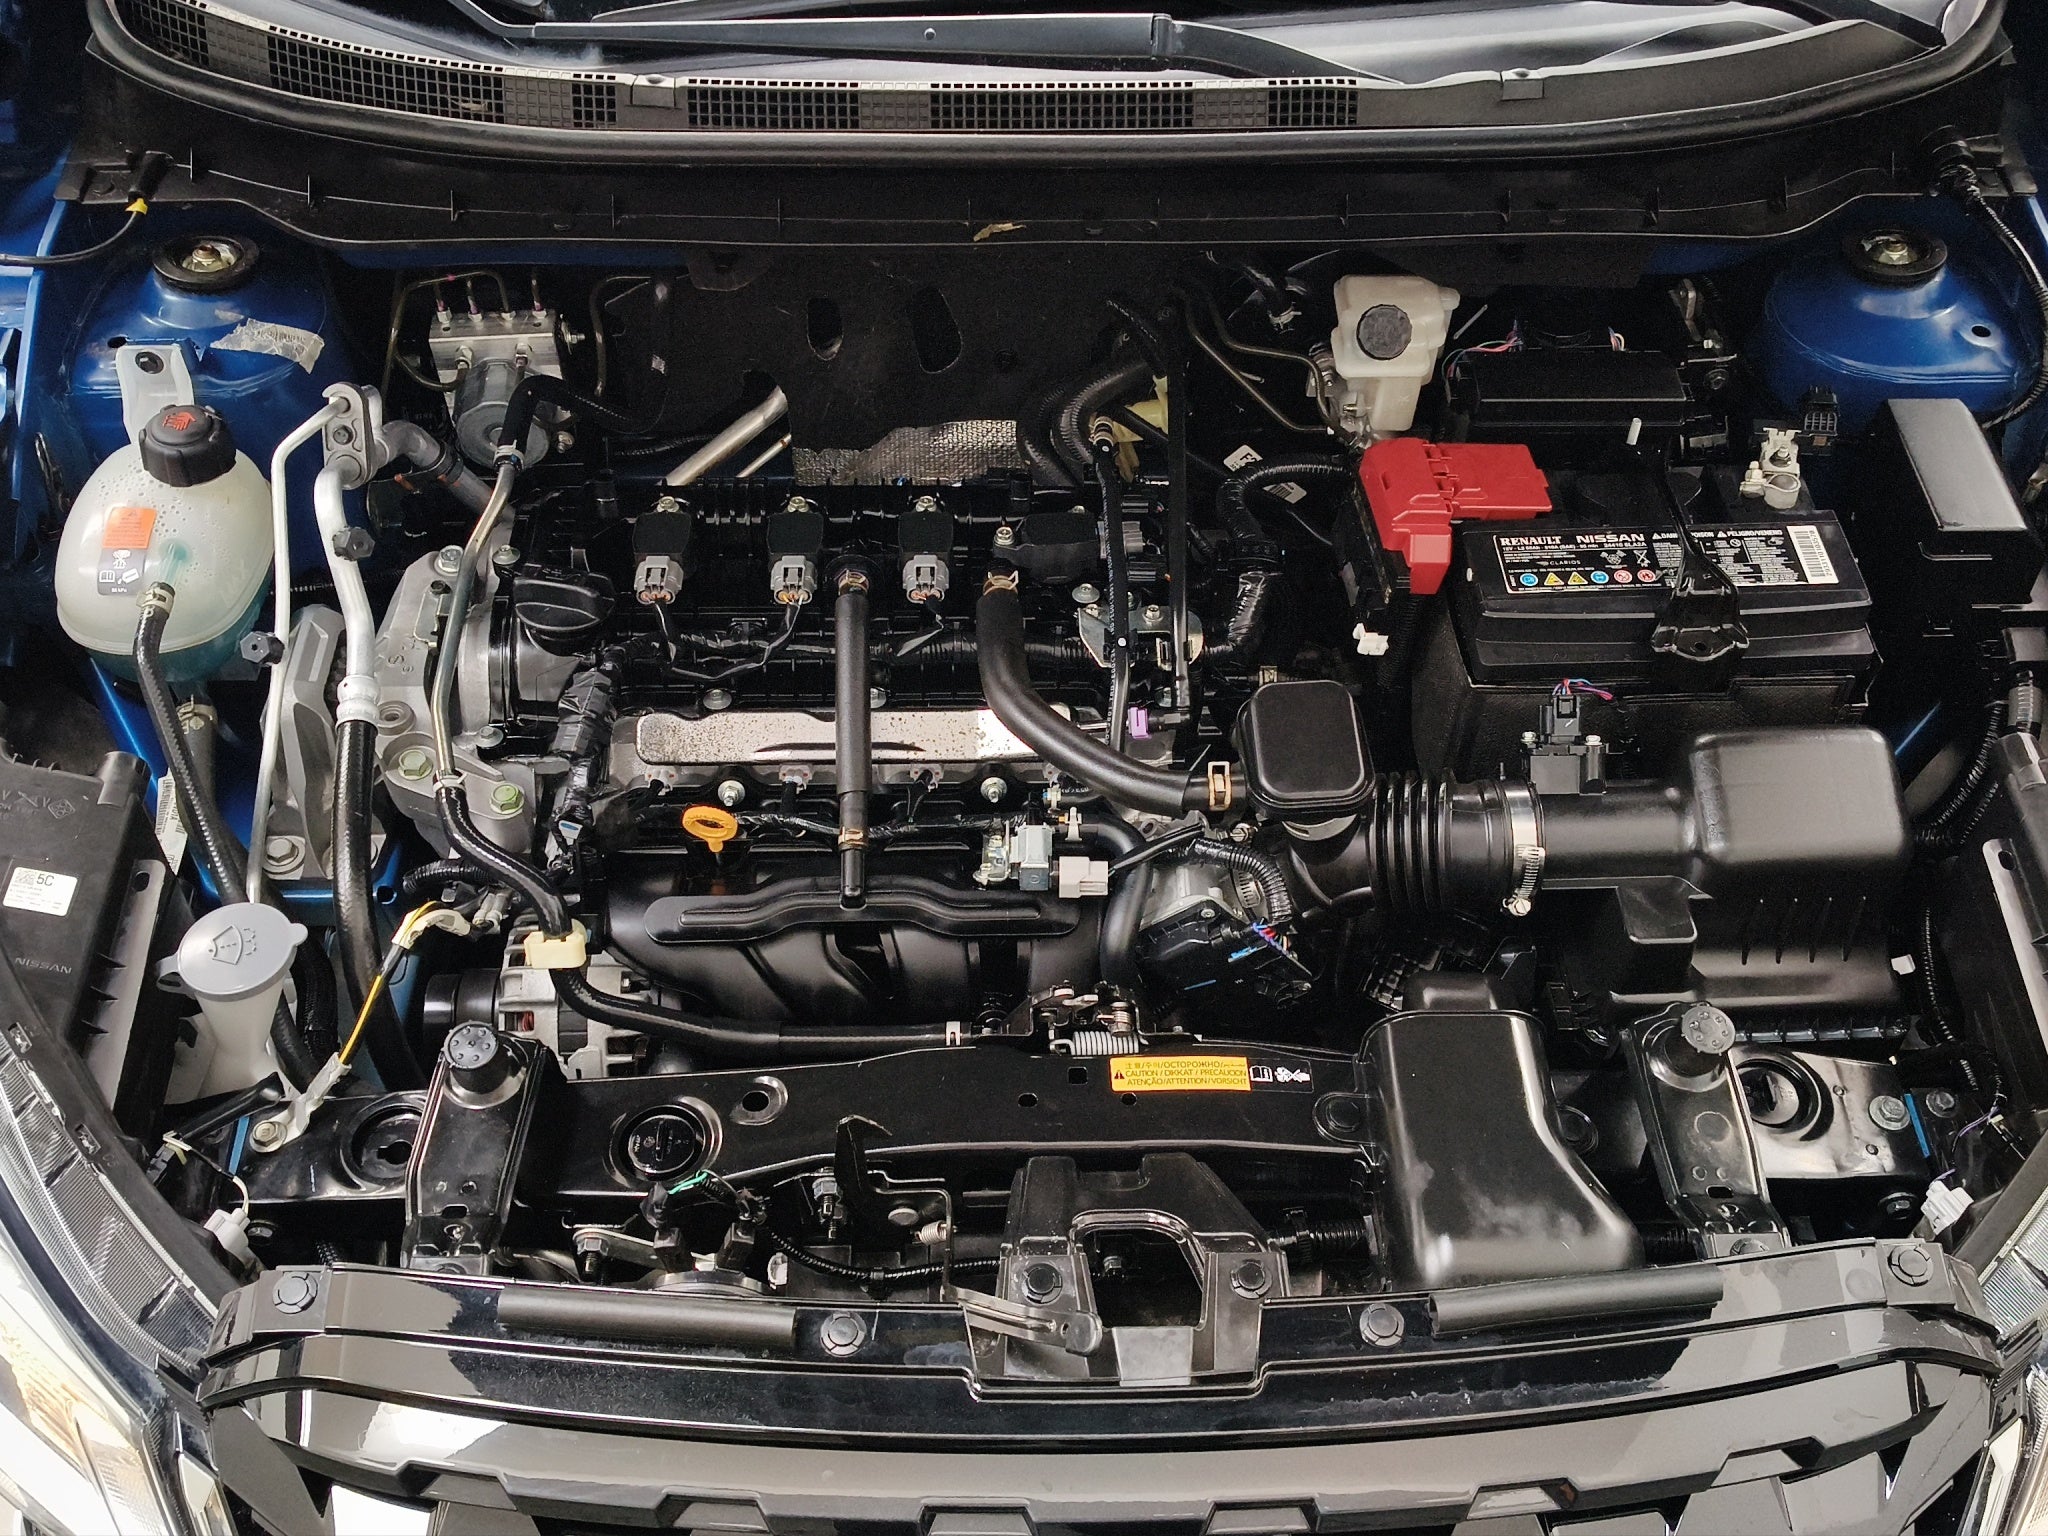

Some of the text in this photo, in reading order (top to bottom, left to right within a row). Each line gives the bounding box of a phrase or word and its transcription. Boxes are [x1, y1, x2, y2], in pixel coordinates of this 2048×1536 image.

[1500, 533, 1646, 546] RENAULT NISSAN
[36, 873, 55, 887] 5C
[14, 957, 72, 975] NISSAN
[1125, 1069, 1159, 1077] CAUTION
